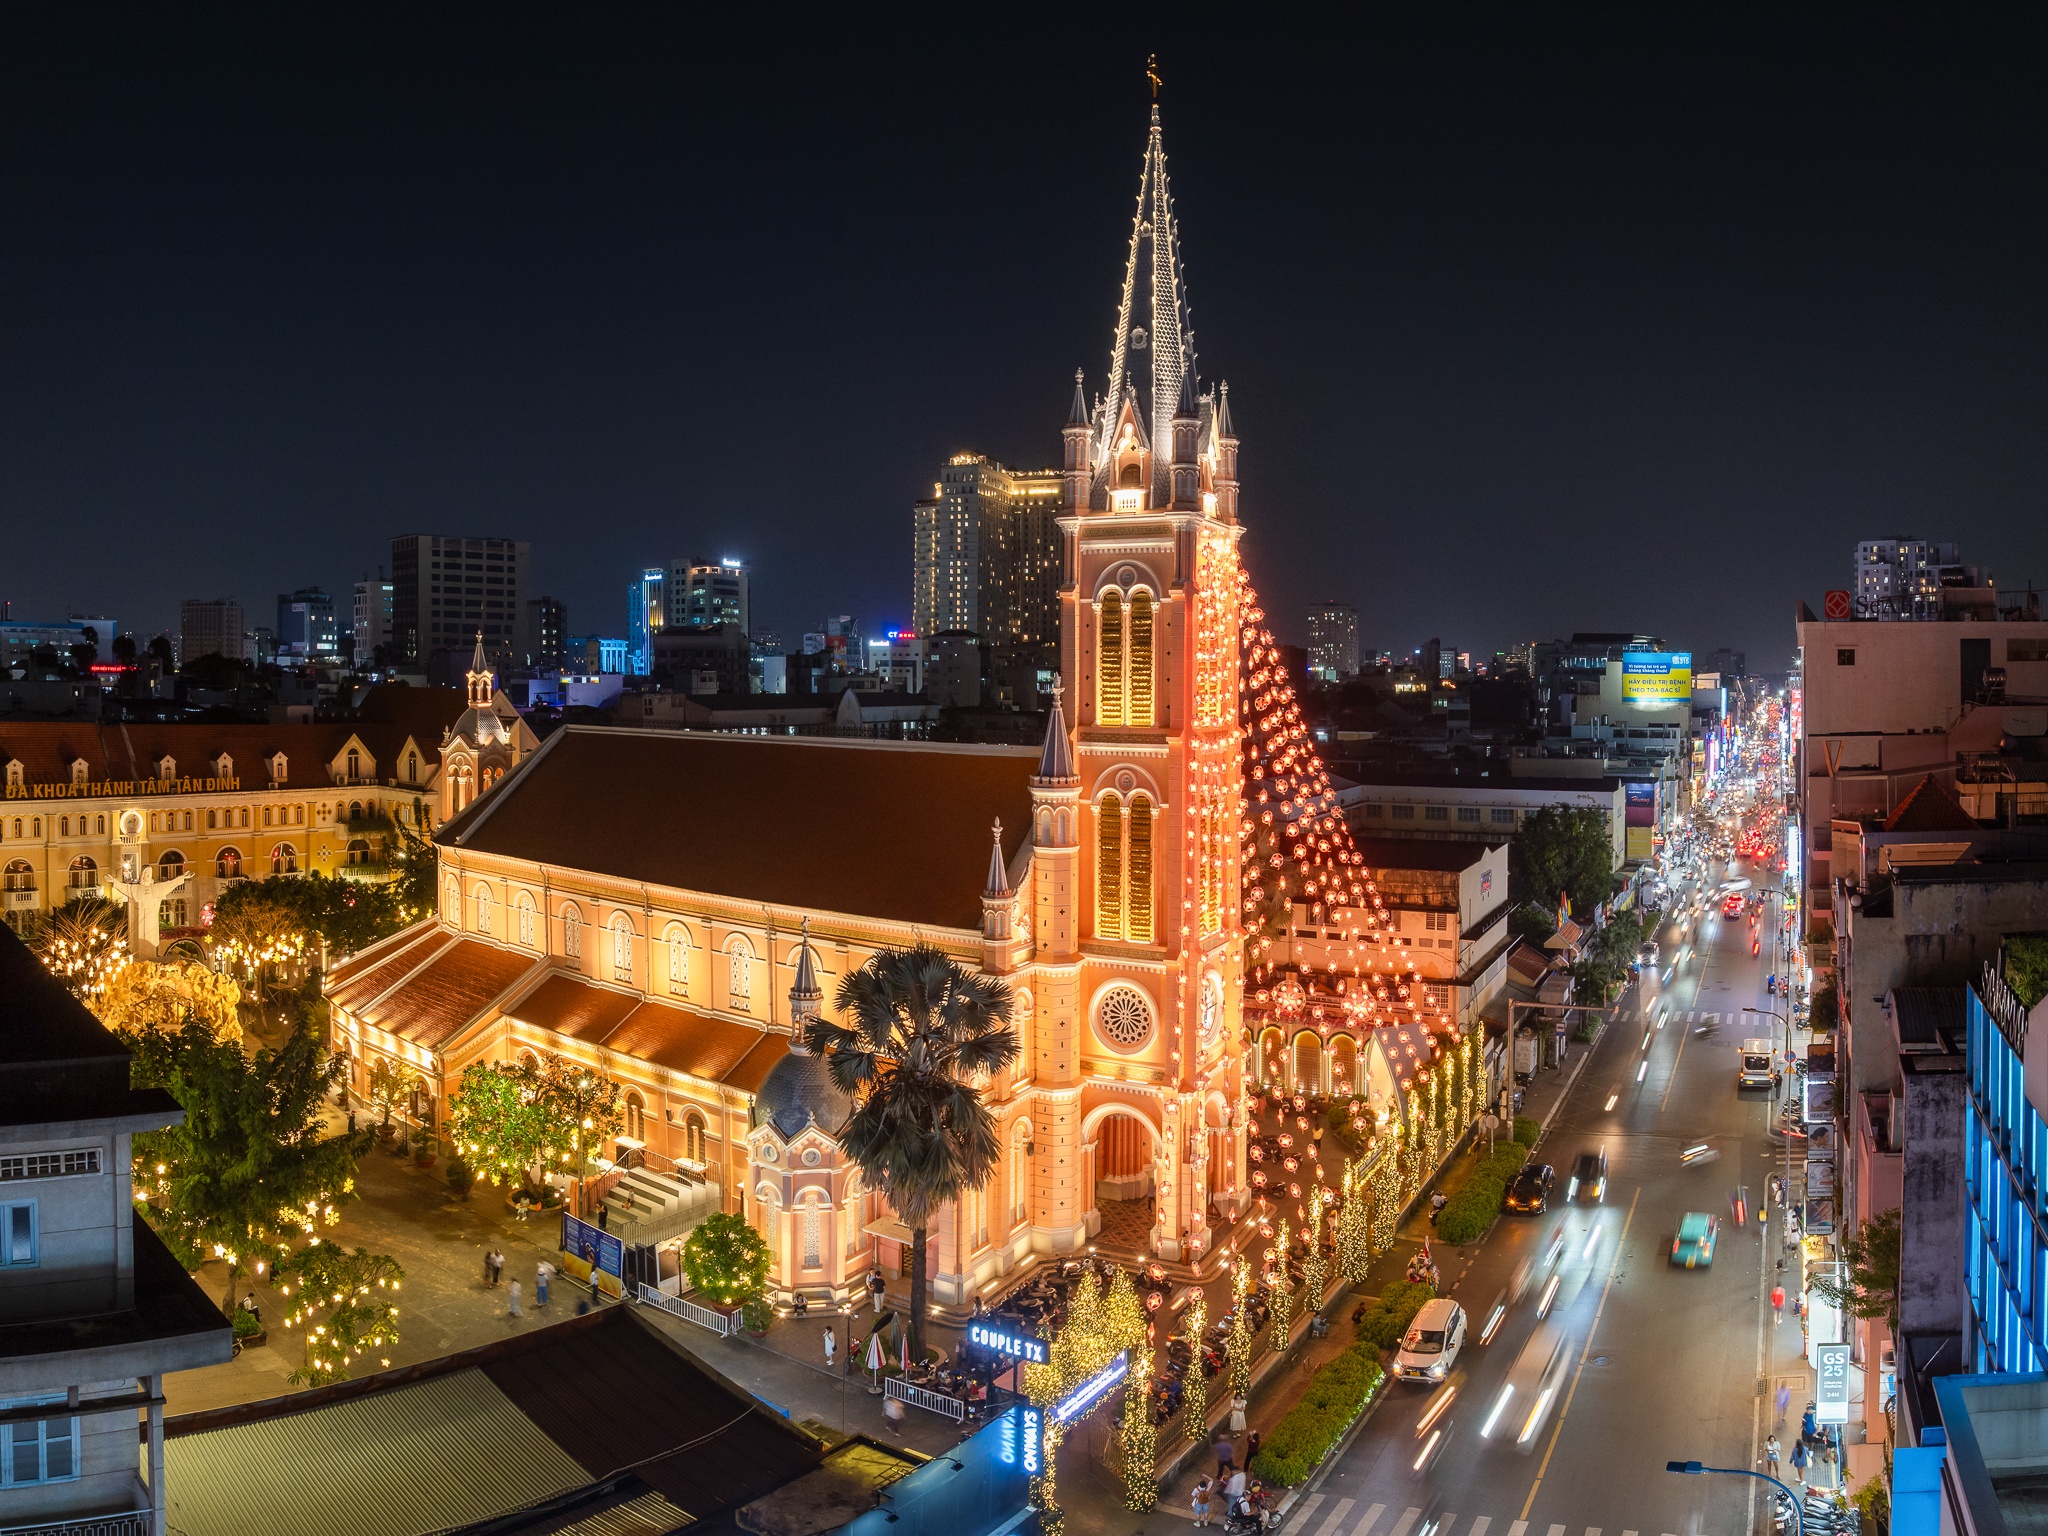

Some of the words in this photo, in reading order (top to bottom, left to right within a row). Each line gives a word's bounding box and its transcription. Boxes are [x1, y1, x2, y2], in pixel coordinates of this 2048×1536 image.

[5, 784, 29, 799] ĐA
[33, 783, 78, 798] KHOA
[81, 778, 134, 797] THÁNH
[140, 776, 170, 794] TÂM
[175, 775, 202, 794] TÂN
[972, 1326, 1021, 1356] COUPLE
[1024, 1342, 1042, 1362] TX
[1823, 1352, 1845, 1365] GS
[1823, 1365, 1844, 1377] 25
[1023, 1410, 1038, 1472] ONWAYS
